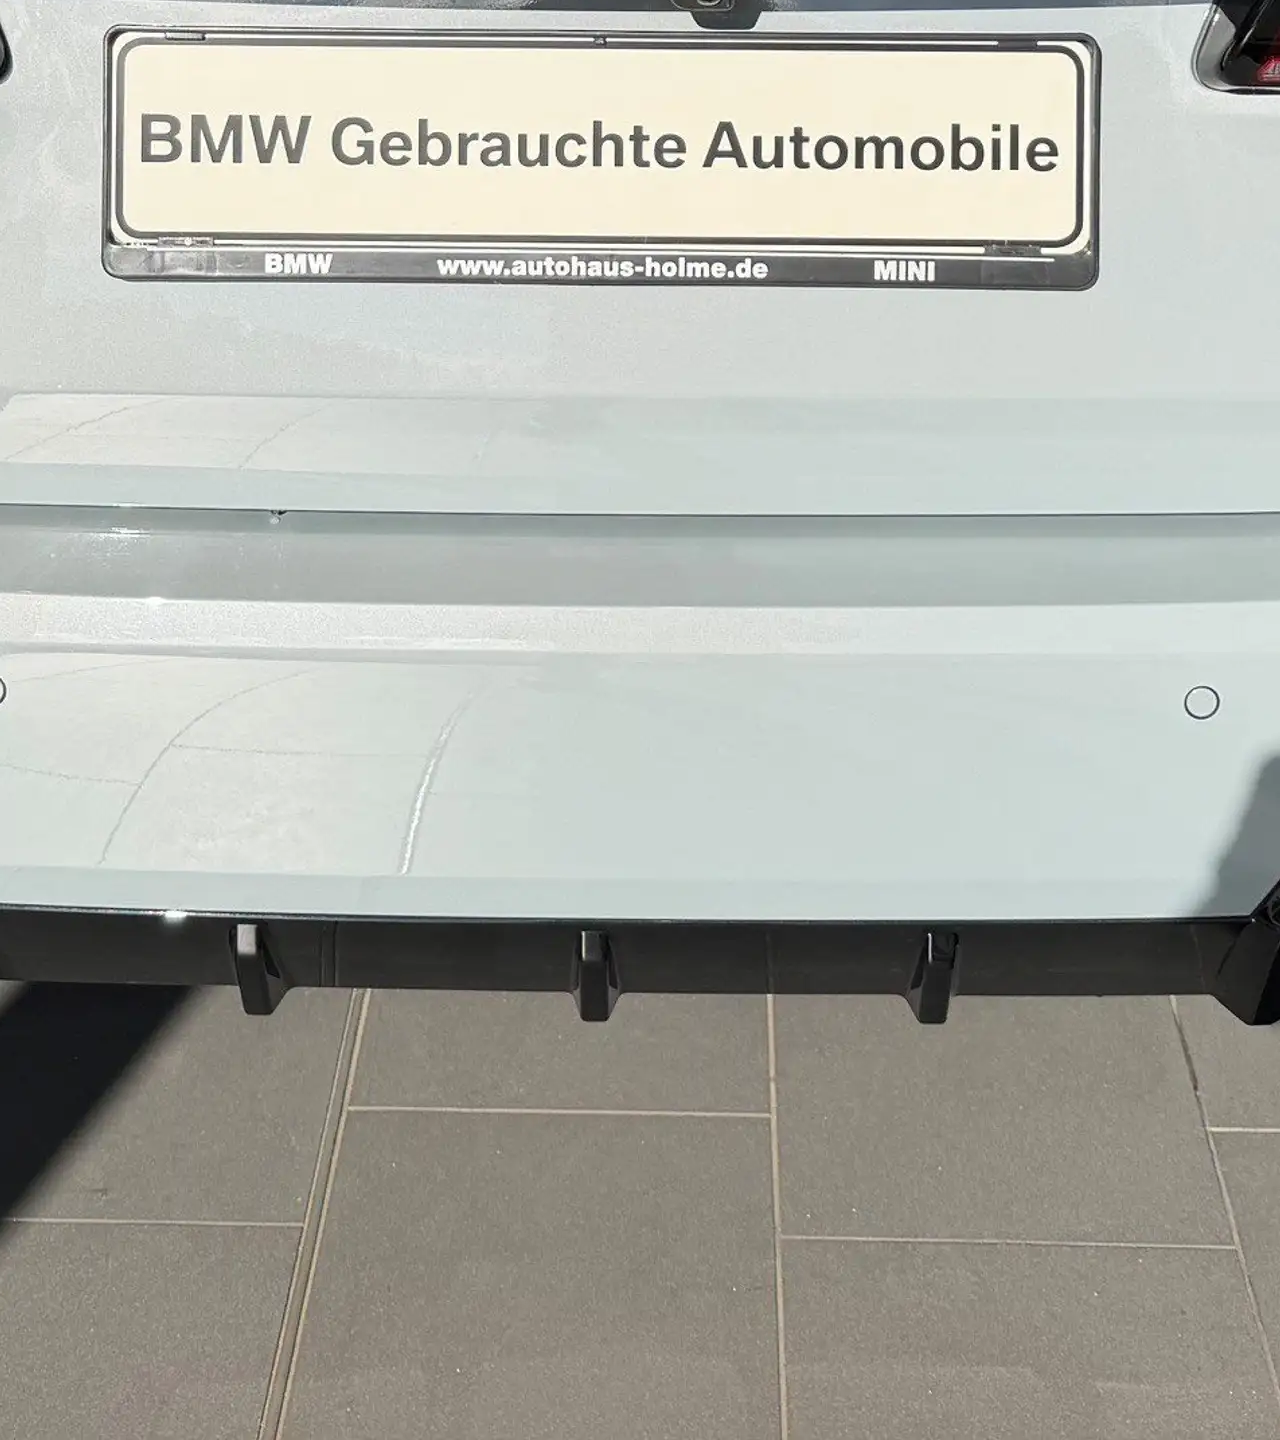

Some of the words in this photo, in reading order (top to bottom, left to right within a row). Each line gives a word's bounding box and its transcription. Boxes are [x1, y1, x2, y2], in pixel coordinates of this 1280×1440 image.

[140, 112, 312, 165] BMW
[331, 116, 687, 168] Gebrauchte
[702, 120, 1060, 172] Automobile
[264, 252, 334, 275] BMW
[436, 255, 769, 281] www.autohaus-holme.de
[873, 259, 937, 283] MINI
